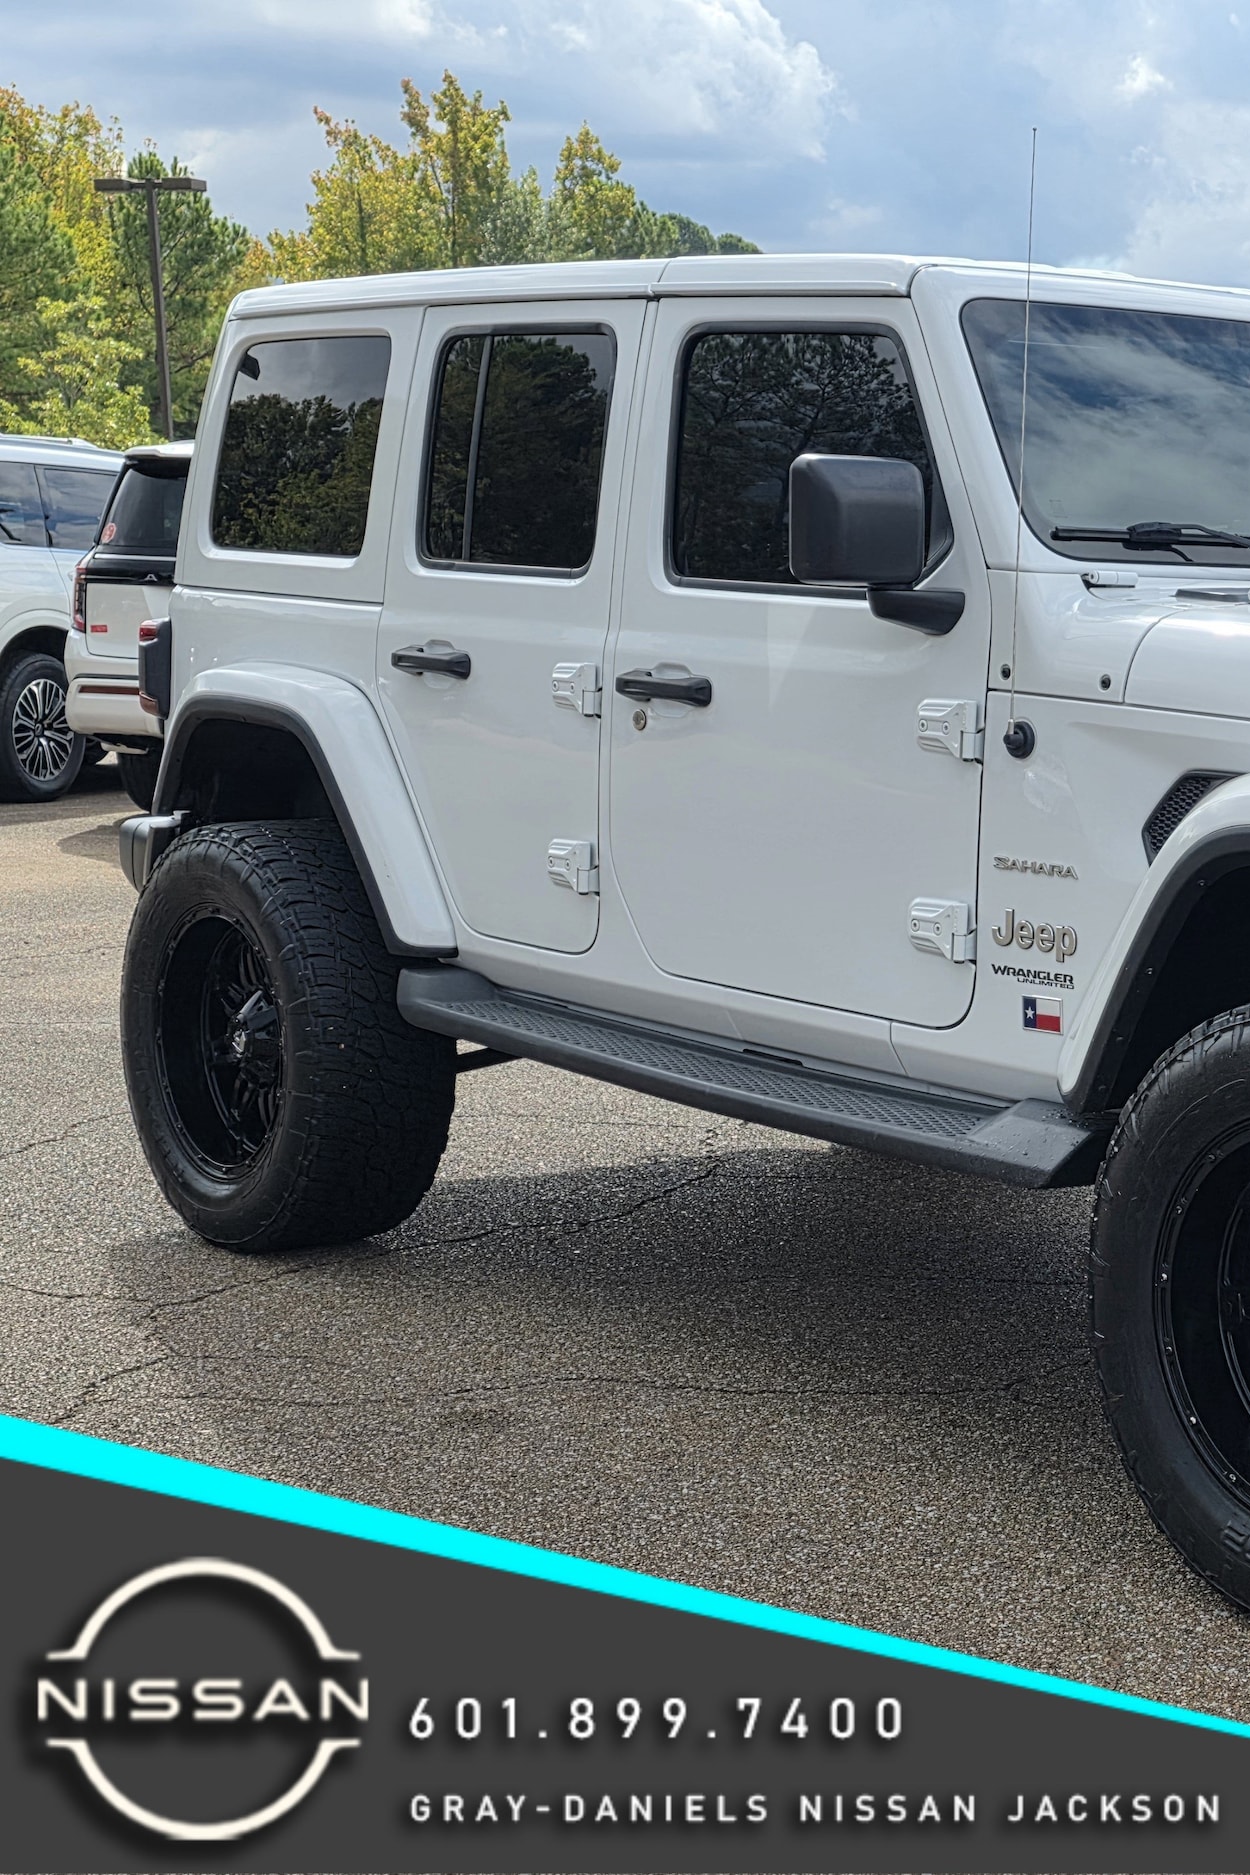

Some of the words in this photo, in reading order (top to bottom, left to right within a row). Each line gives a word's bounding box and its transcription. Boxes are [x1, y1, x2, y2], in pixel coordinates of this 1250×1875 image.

[993, 855, 1079, 880] SAHARA
[991, 907, 1078, 963] Jeep
[991, 963, 1074, 985] WRANGLER
[1016, 977, 1075, 990] UNLIMITED
